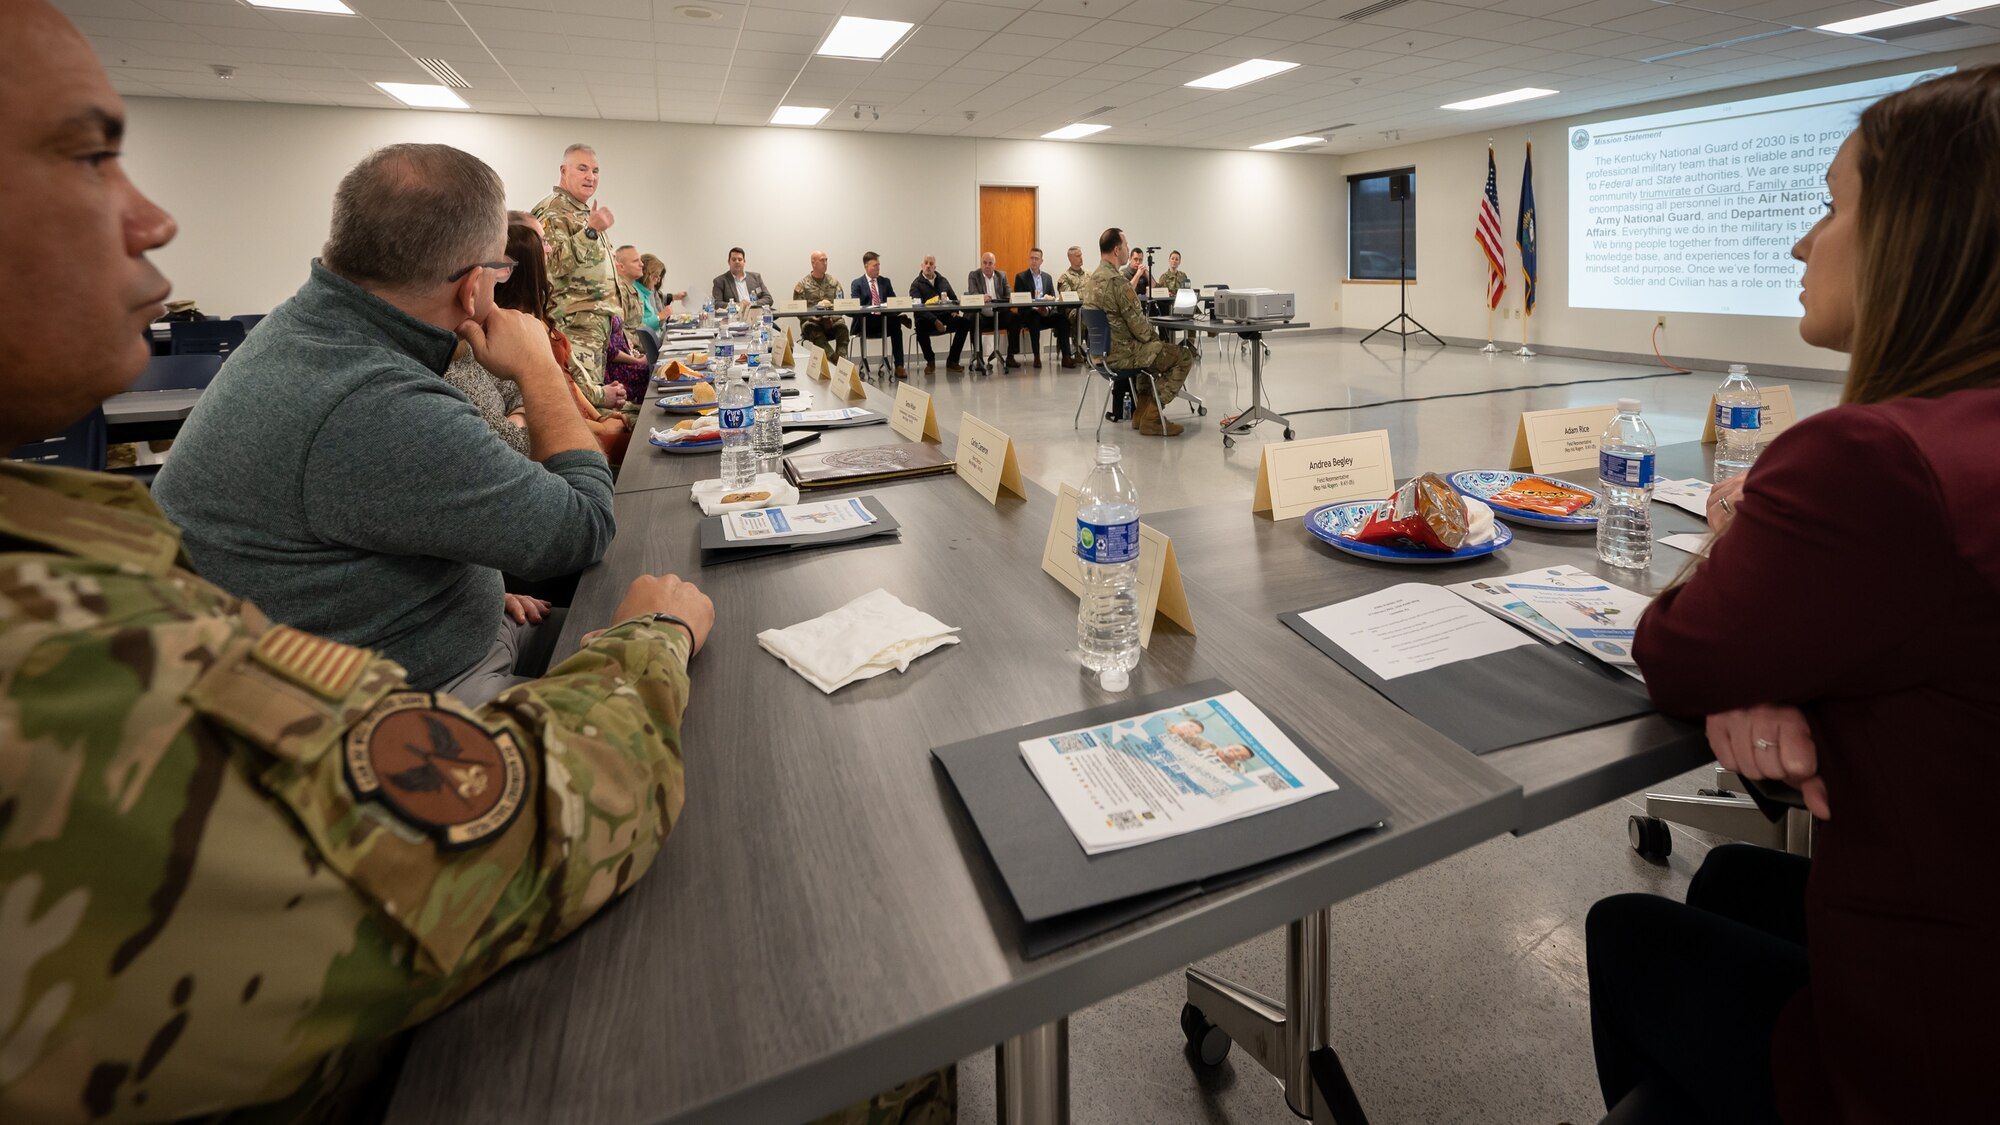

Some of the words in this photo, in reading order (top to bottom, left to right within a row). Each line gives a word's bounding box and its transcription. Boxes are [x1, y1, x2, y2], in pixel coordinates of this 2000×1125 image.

[1594, 136, 1622, 146] Mission
[1624, 131, 1662, 142] Statement
[1594, 156, 1612, 166] The
[1614, 150, 1657, 164] Kentucky
[1660, 144, 1701, 159] National
[1704, 141, 1738, 154] Guard
[1742, 139, 1753, 150] of
[1756, 134, 1786, 148] 2030
[1790, 134, 1800, 144] is
[1803, 132, 1816, 143] to
[1586, 165, 1640, 180] professional
[1642, 162, 1676, 174] military
[1680, 160, 1705, 170] team
[1708, 156, 1728, 167] that
[1732, 155, 1740, 165] is
[1744, 150, 1787, 163] reliable
[1790, 147, 1814, 159] and
[1588, 182, 1598, 190] to
[1600, 178, 1634, 189] Federal
[1635, 176, 1653, 187] and
[1656, 174, 1682, 184] State
[1684, 170, 1744, 182] authorities.
[1746, 167, 1766, 177] We
[1770, 166, 1789, 175] are
[1589, 190, 1638, 202] community
[1640, 186, 1691, 198] triumvirate
[1694, 186, 1704, 195] of
[1707, 182, 1744, 194] Guard,
[1748, 179, 1787, 191] Family
[1790, 176, 1814, 188] and
[1588, 202, 1654, 214] encompassing
[1656, 200, 1667, 210] all
[1670, 197, 1720, 211] personnel
[1724, 196, 1734, 206] in
[1737, 195, 1755, 205] the
[1758, 193, 1777, 204] Air
[1595, 216, 1620, 227] Army
[1623, 213, 1664, 223] National
[1668, 211, 1704, 222] Guard,
[1707, 210, 1728, 220] and
[1731, 206, 1805, 220] Department
[1808, 204, 1822, 216] of
[1622, 226, 1672, 238] Everything
[1674, 226, 1689, 234] we
[1692, 224, 1705, 234] do
[1708, 224, 1718, 233] in
[1720, 222, 1738, 233] the
[1741, 221, 1783, 233] military
[1786, 220, 1796, 231] is
[1592, 240, 1608, 249] We
[1610, 239, 1632, 251] bring
[1634, 239, 1666, 250] people
[1669, 238, 1712, 250] together
[1714, 237, 1739, 246] from
[1742, 235, 1790, 246] different
[1585, 252, 1632, 263] knowledge
[1663, 251, 1682, 261] and
[1685, 250, 1750, 262] experiences
[1753, 249, 1768, 260] for
[1772, 251, 1780, 260] a
[1585, 264, 1620, 273] mindset
[1622, 264, 1640, 273] and
[1642, 264, 1684, 275] purpose.
[1687, 264, 1715, 274] Once
[1753, 263, 1799, 276] formed,
[1613, 275, 1645, 286] Soldier
[1648, 276, 1666, 286] and
[1668, 276, 1705, 287] Civilian
[1708, 277, 1728, 287] has
[1731, 279, 1738, 288] a
[1741, 277, 1763, 288] role
[1766, 279, 1782, 288] on
[1564, 426, 1578, 435] Adam
[1578, 425, 1590, 433] Rice
[1309, 460, 1332, 470] Andrea
[1332, 456, 1354, 468] Begley
[1325, 474, 1350, 482] Representative
